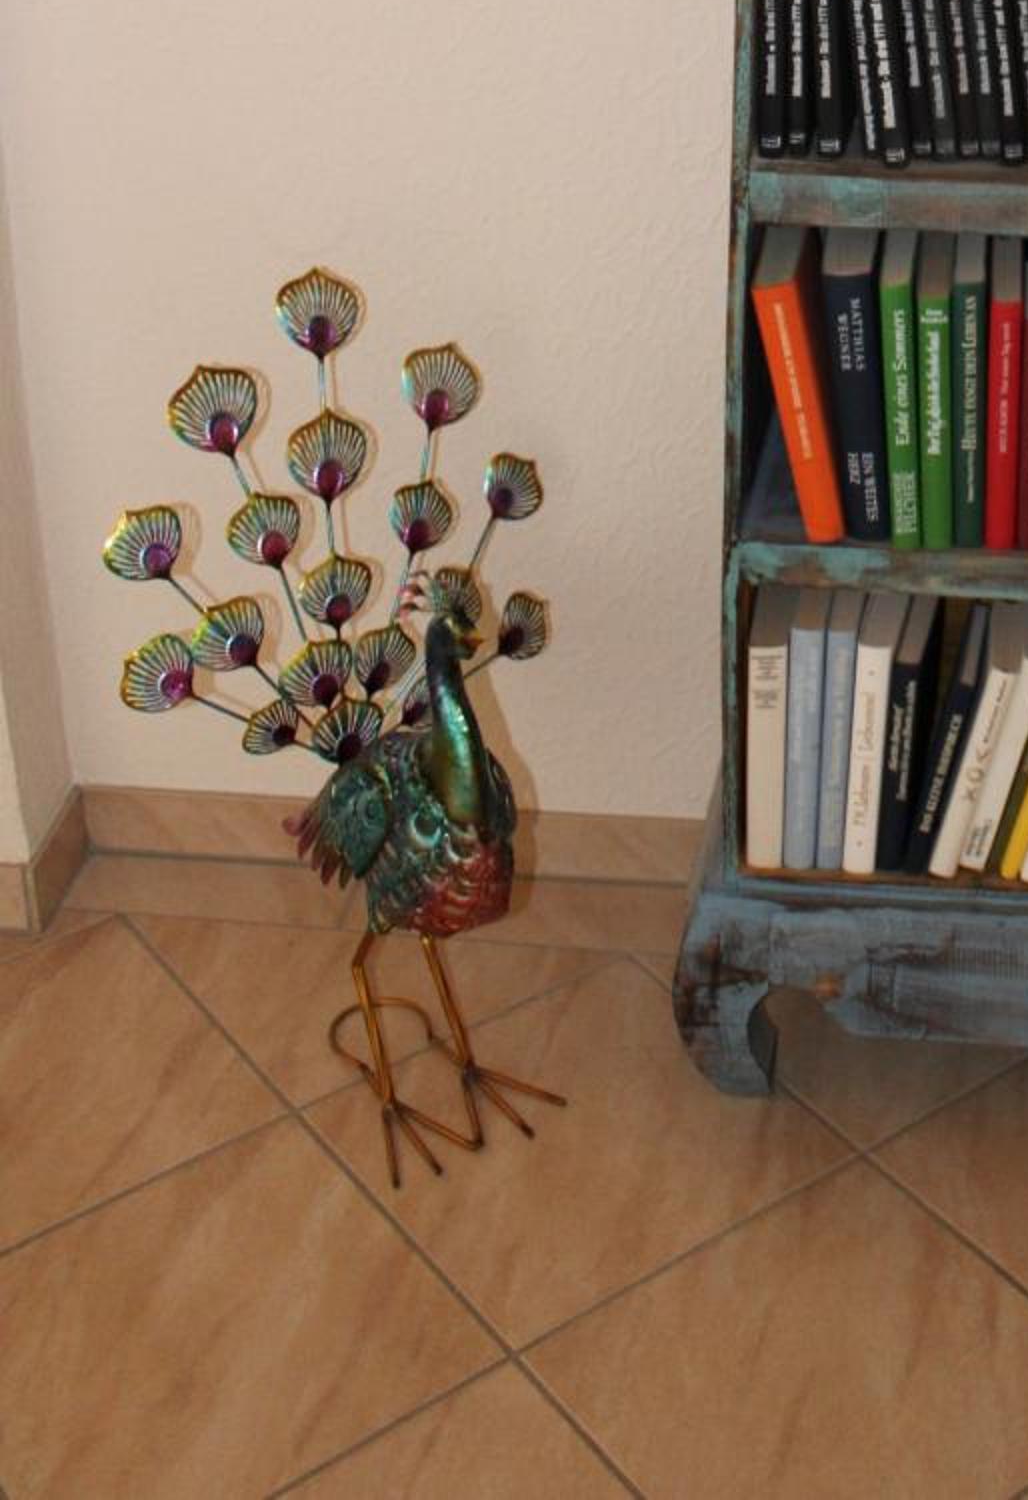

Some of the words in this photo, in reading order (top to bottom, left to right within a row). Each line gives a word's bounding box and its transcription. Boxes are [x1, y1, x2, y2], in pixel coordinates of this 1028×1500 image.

[838, 313, 851, 372] WEGNER
[850, 298, 865, 372] MATTHIAS
[892, 309, 907, 372] Sommers
[892, 411, 910, 446] Ende
[848, 452, 861, 485] HERZ
[861, 452, 875, 474] EIN
